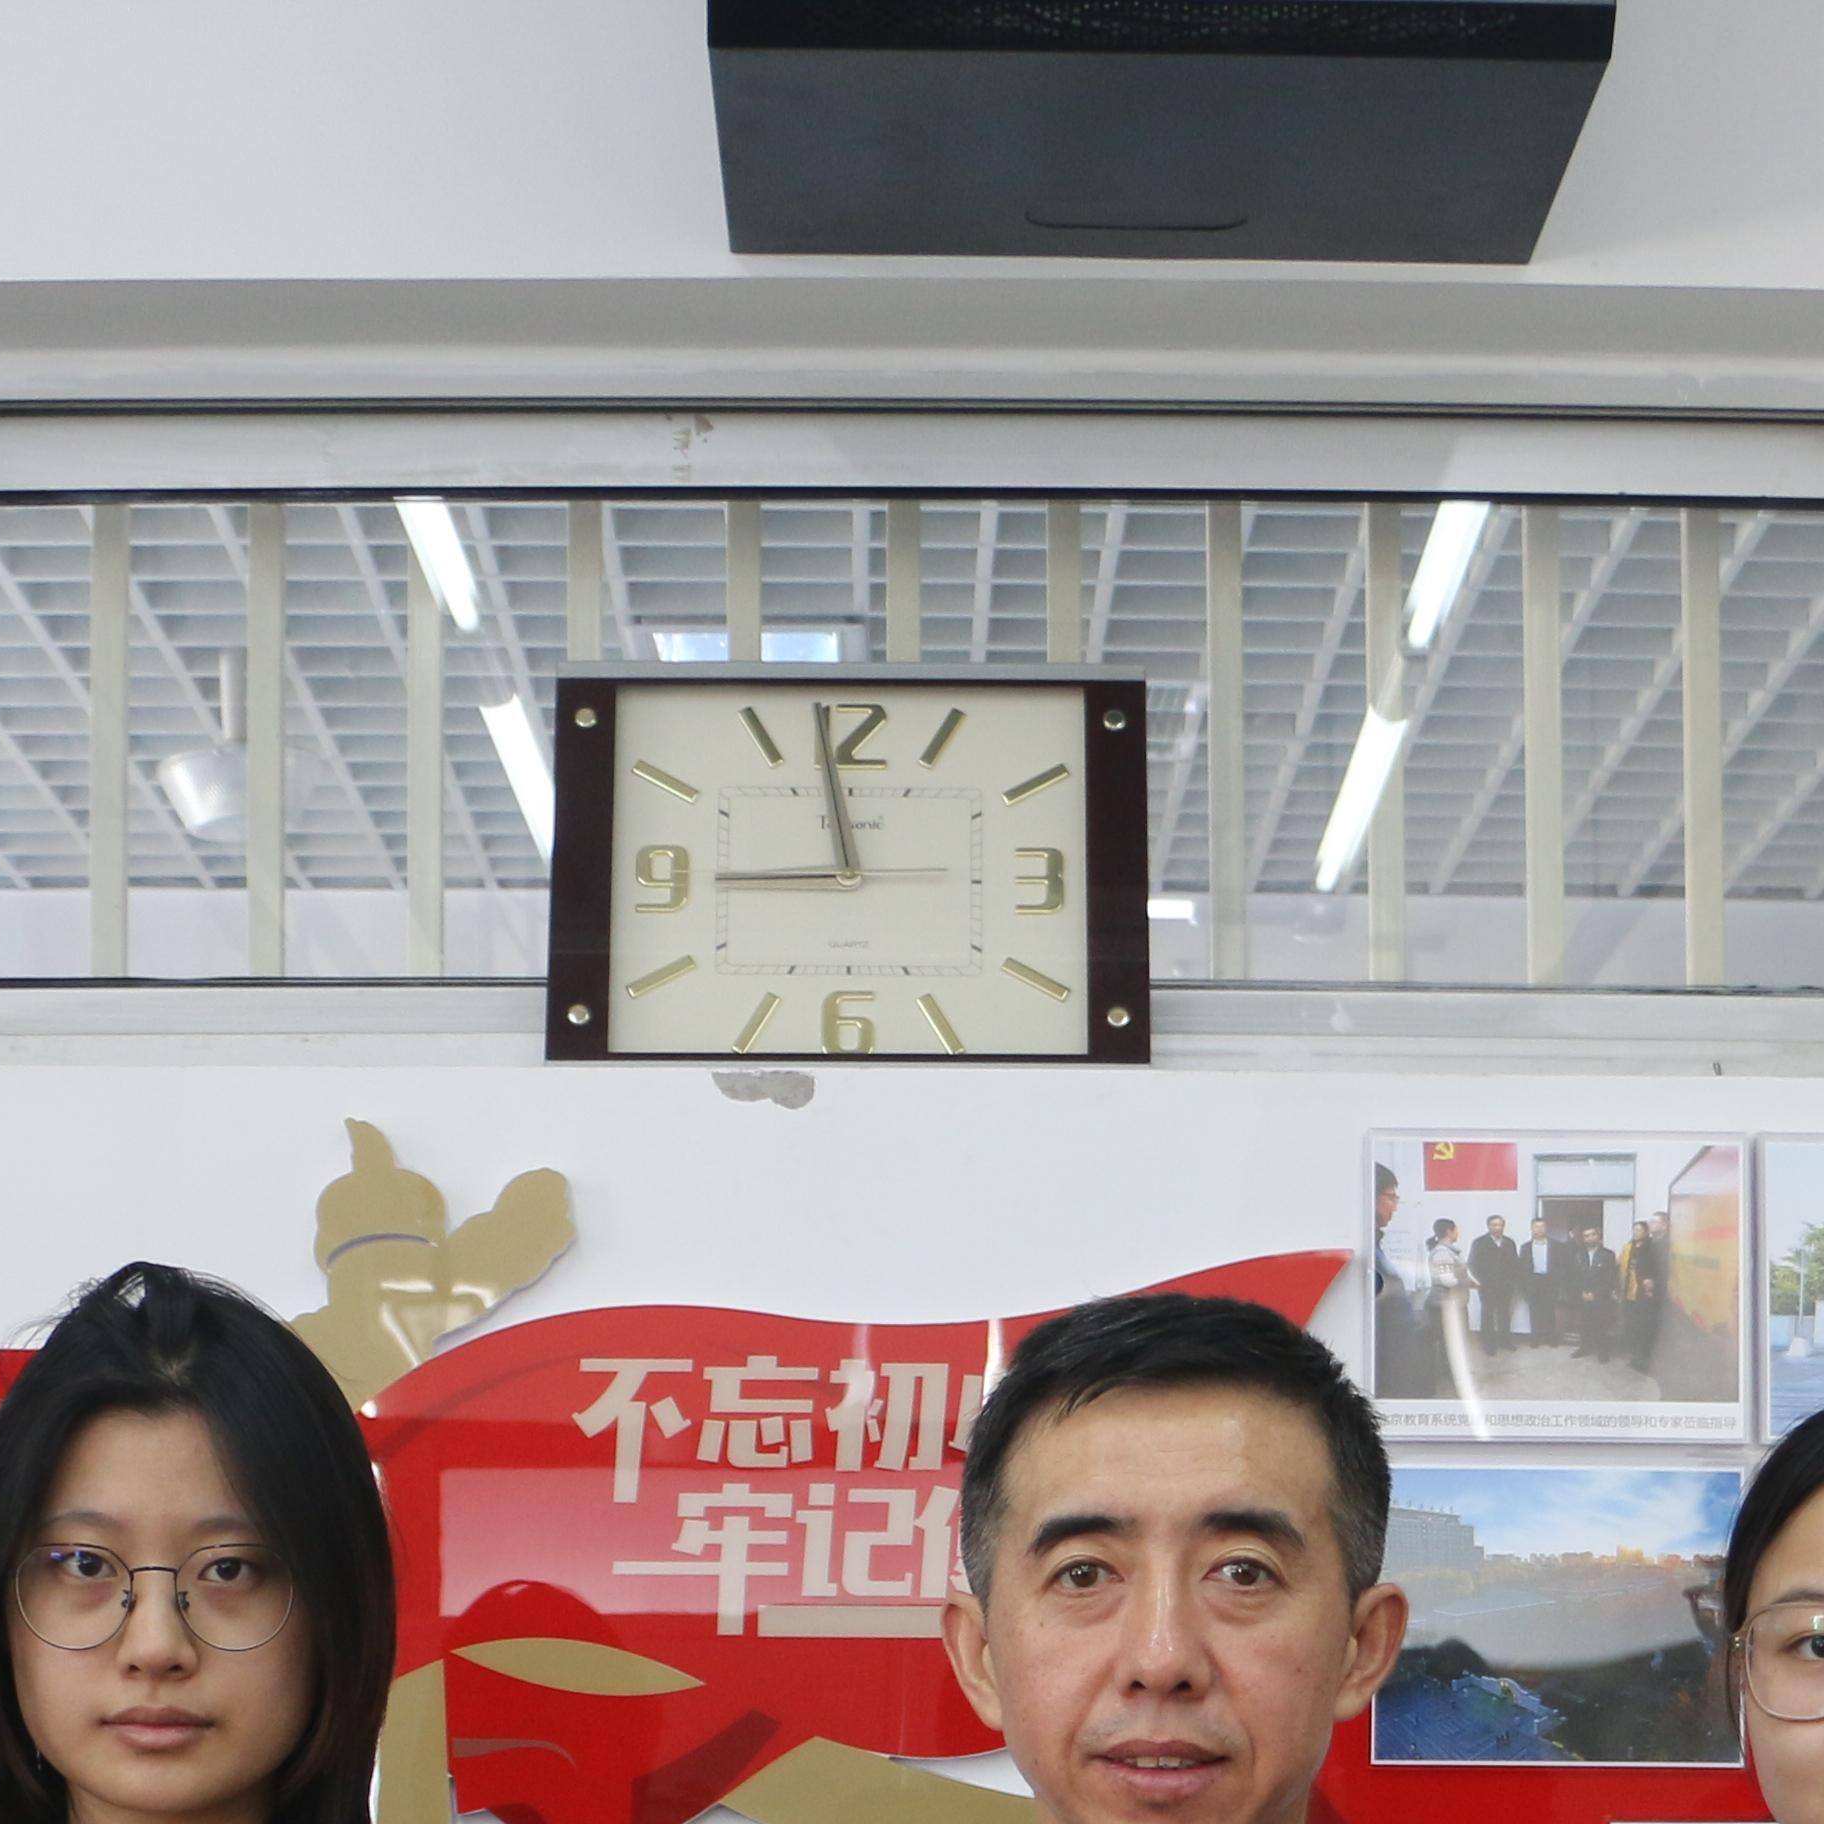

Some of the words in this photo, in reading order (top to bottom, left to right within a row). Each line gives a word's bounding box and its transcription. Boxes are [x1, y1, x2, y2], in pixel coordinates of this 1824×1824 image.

[634, 844, 691, 914] 9
[1013, 846, 1065, 916] 3
[820, 990, 877, 1055] 6
[572, 1355, 983, 1503] 不忘初
[1378, 1412, 1737, 1431] 京教育系统党和思想政治工作领域的领导和专家莅临指导
